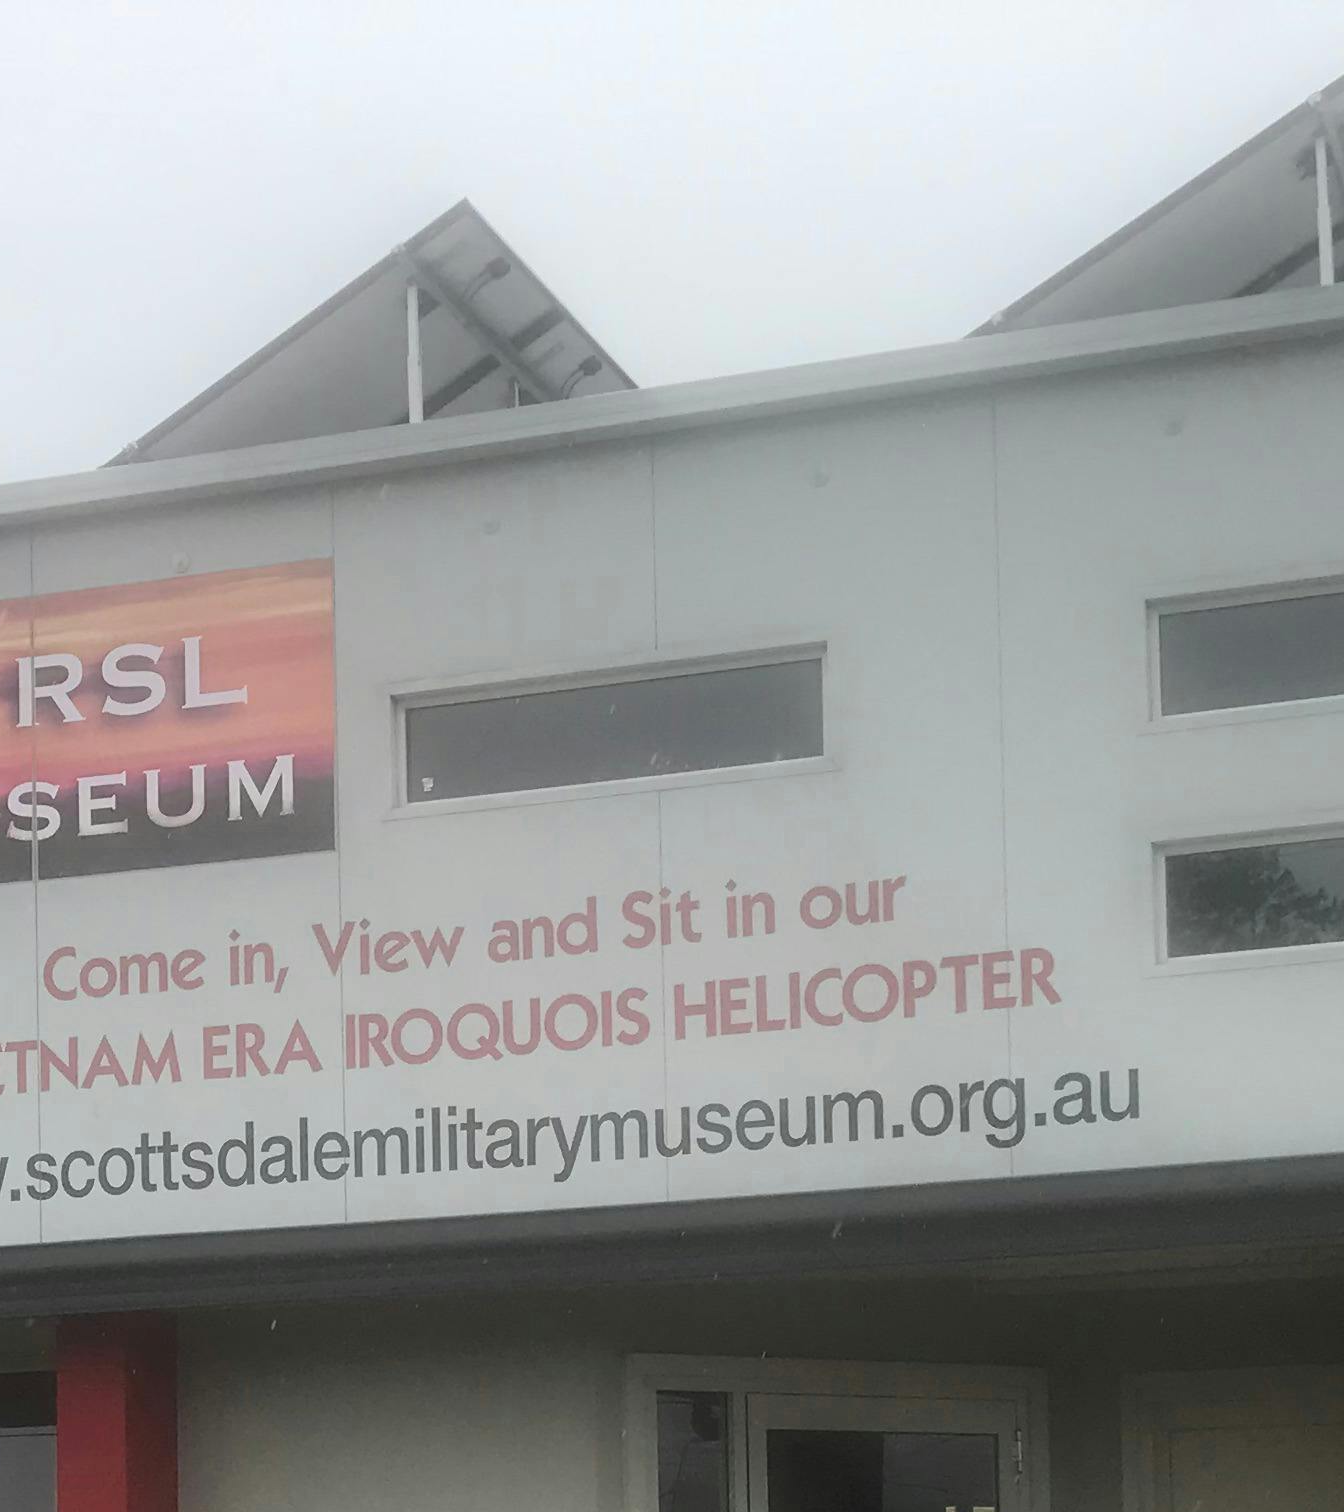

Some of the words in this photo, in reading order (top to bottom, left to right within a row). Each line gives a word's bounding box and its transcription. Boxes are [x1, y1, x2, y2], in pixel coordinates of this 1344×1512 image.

[15, 634, 248, 728] RSL
[43, 944, 205, 1002] Come
[228, 931, 289, 999] in,
[311, 917, 464, 977] View
[487, 897, 598, 962] and
[621, 887, 702, 948] Sit
[725, 880, 775, 938] in
[799, 876, 905, 930] our
[202, 1018, 323, 1082] ERA
[344, 987, 650, 1070] IROQUOIS
[673, 947, 1062, 1042] HELICOPTER
